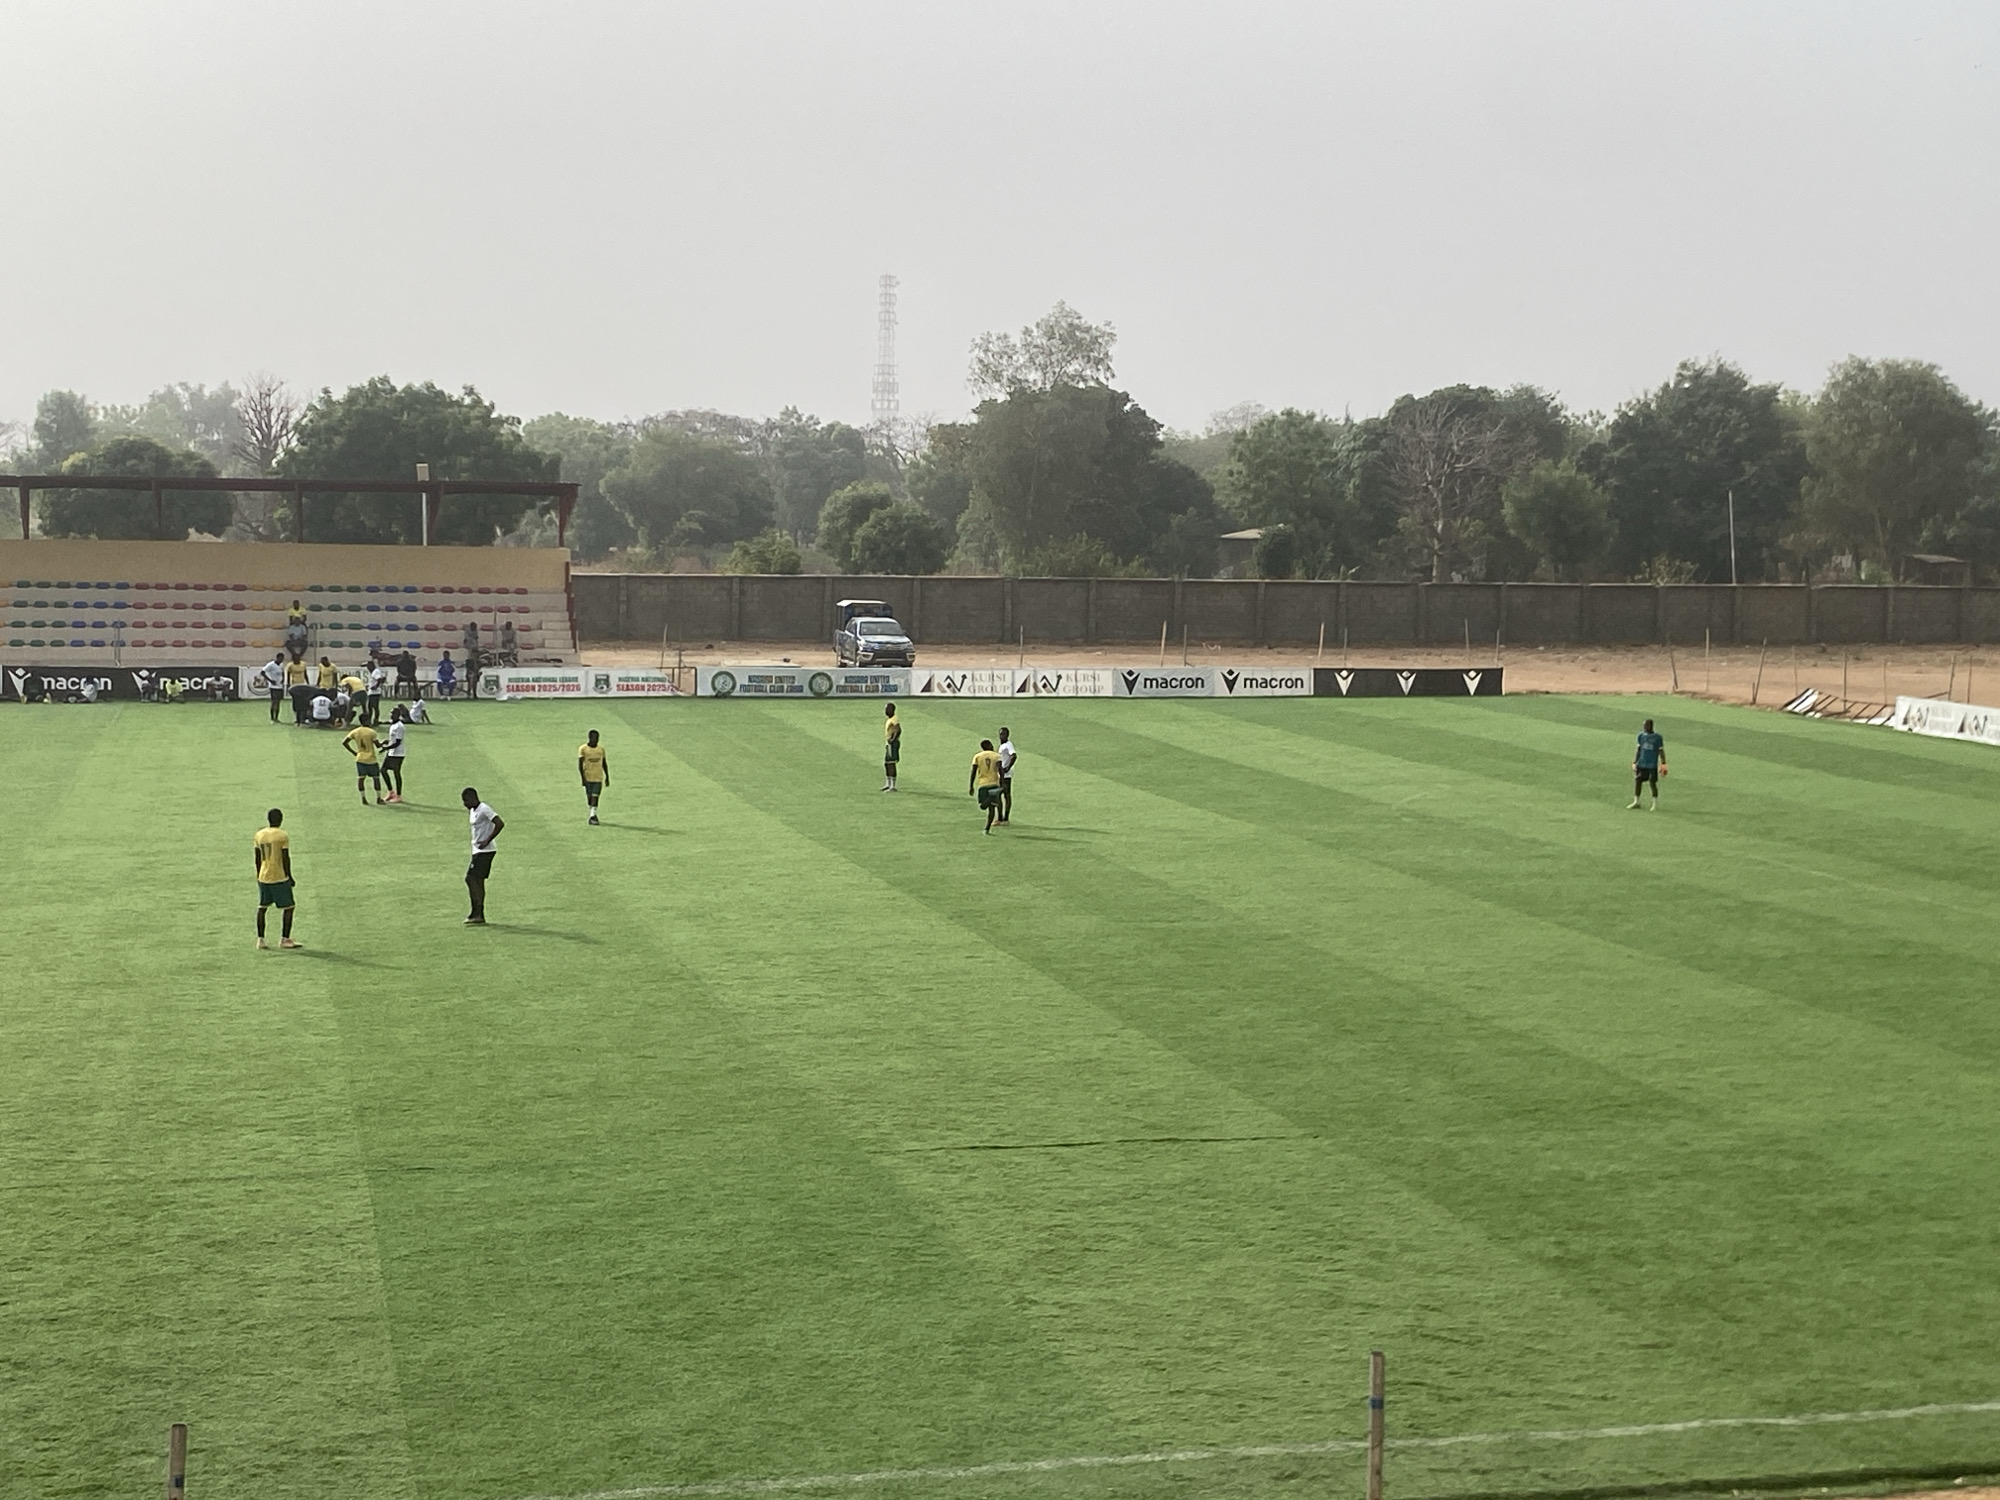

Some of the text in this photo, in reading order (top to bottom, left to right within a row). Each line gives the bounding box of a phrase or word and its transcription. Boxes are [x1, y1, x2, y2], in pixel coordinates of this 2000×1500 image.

[971, 673, 1006, 682] KURSI
[1066, 673, 1101, 682] KURSI
[1143, 676, 1205, 689] macron
[1243, 676, 1304, 689] macron
[159, 677, 234, 690] acrn
[506, 683, 581, 692] SEASON 2025/2026
[616, 684, 645, 692] SEASON
[968, 684, 1011, 694] GROUP
[1063, 684, 1105, 694] GROUP
